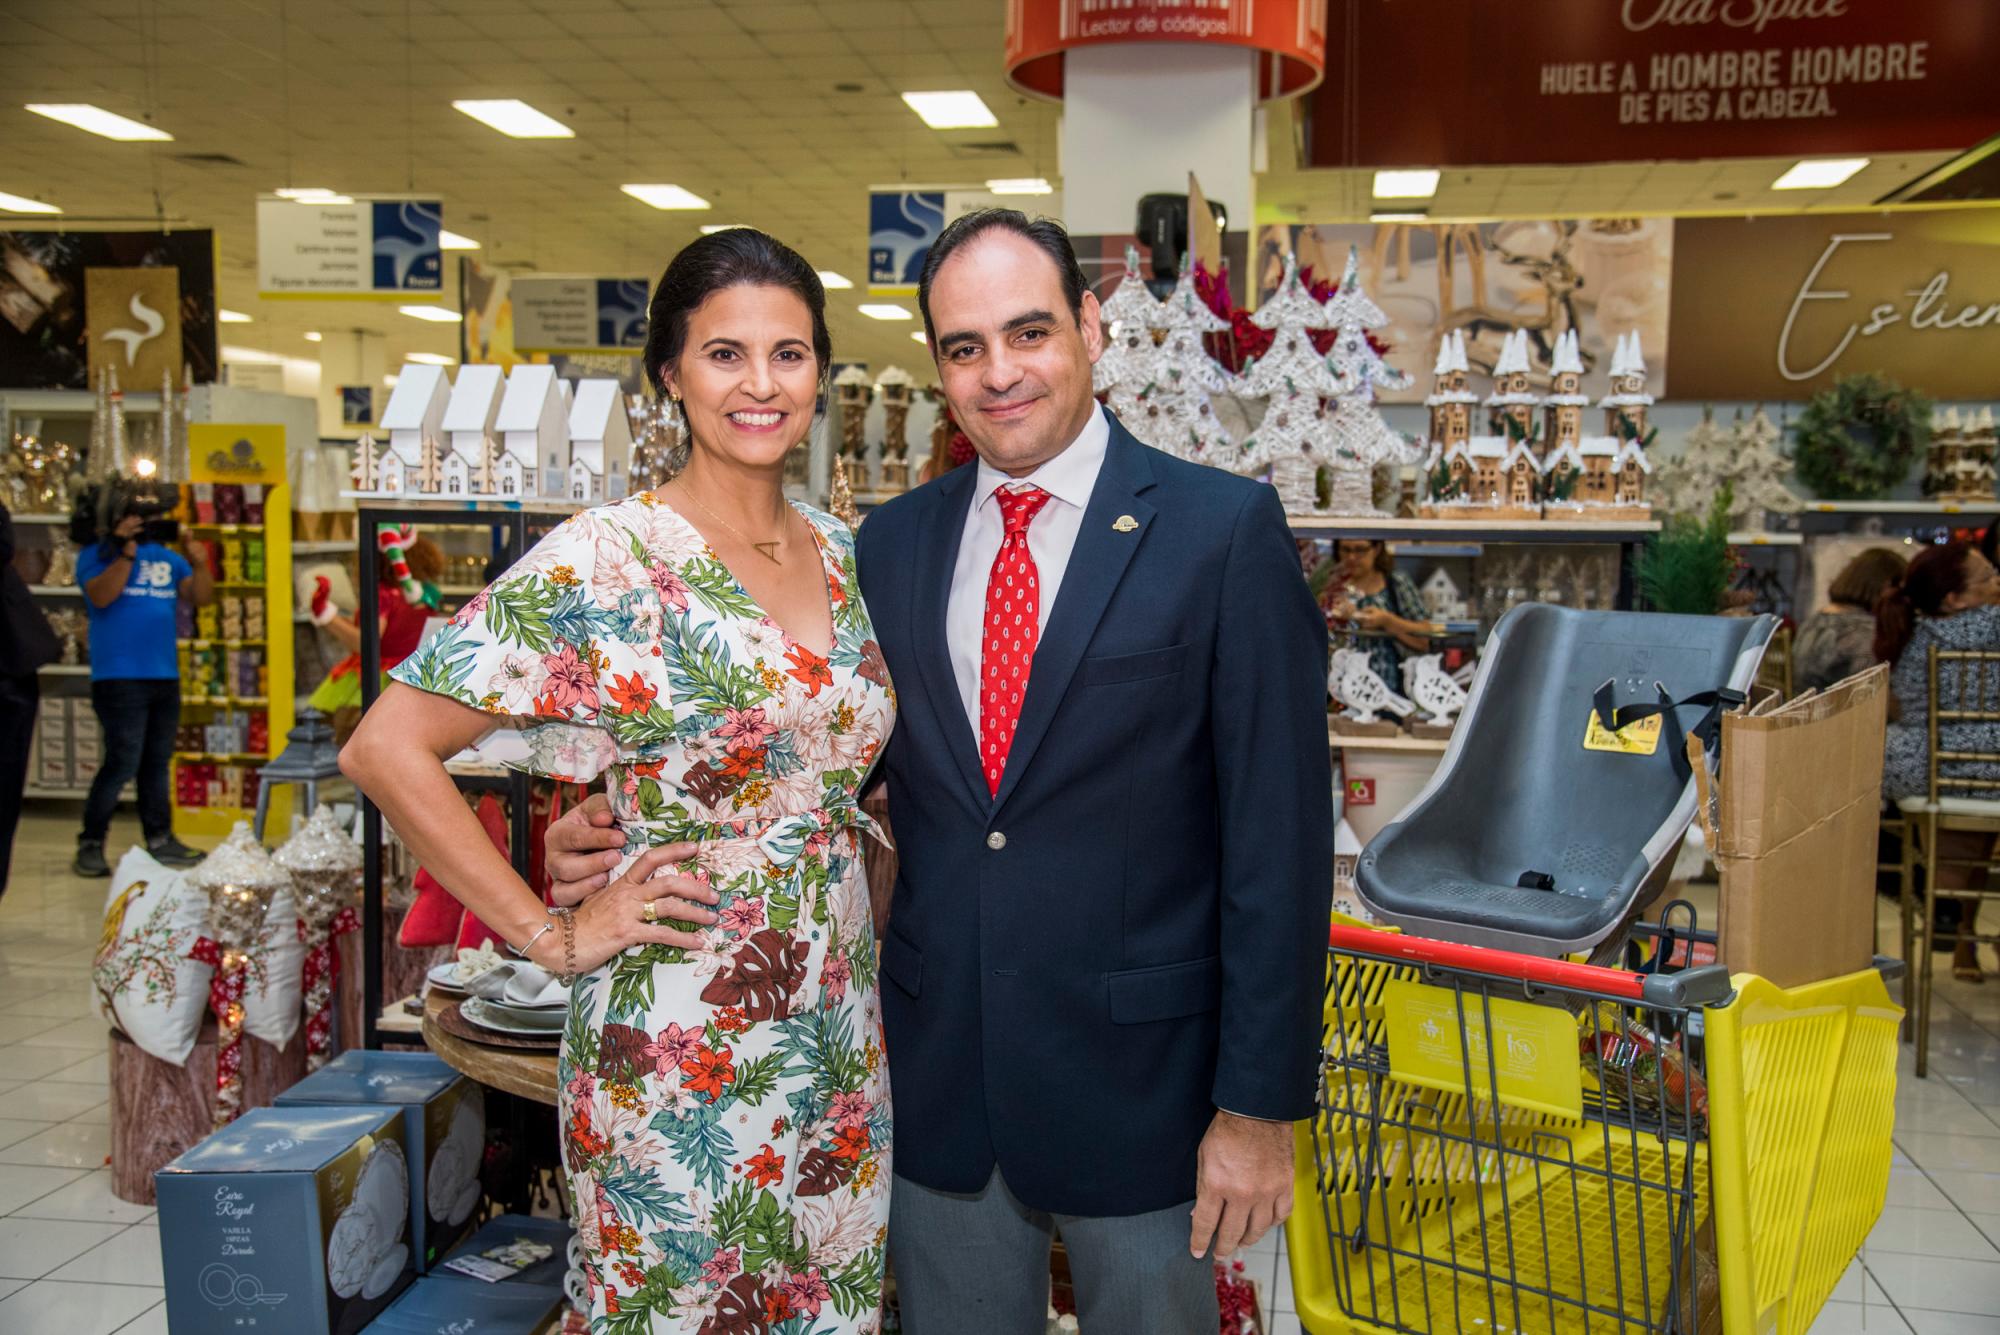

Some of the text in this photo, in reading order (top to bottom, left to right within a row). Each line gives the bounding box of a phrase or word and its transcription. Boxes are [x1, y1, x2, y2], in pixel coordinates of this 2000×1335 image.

[1080, 18, 1131, 37] Lector
[1134, 14, 1158, 33] de
[1540, 41, 1928, 95] HUELE A HOMBRE HOMBRE
[1619, 87, 1837, 124] DE PIES A CABEZA.
[214, 1185, 244, 1201] Euro
